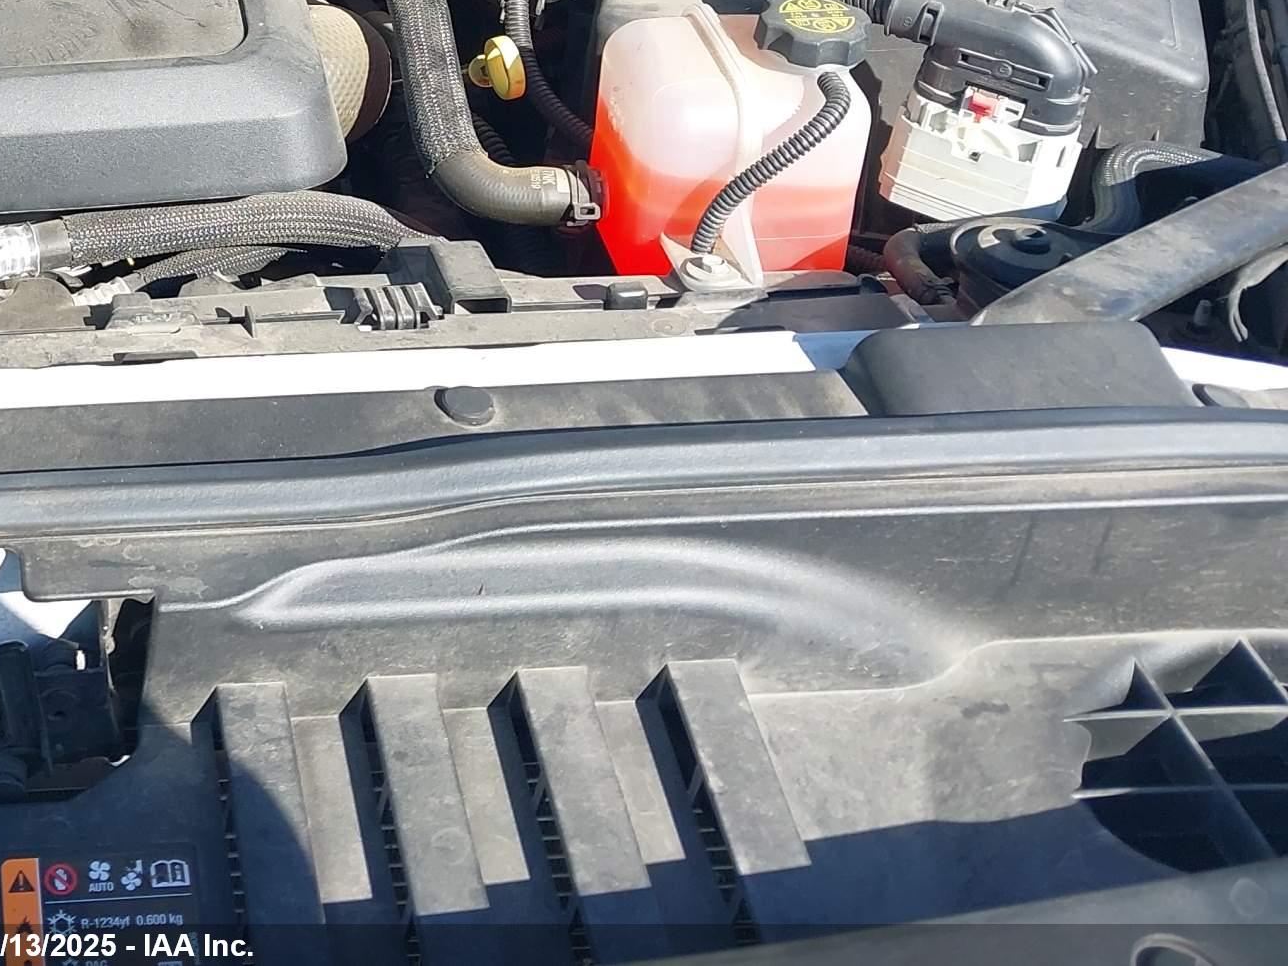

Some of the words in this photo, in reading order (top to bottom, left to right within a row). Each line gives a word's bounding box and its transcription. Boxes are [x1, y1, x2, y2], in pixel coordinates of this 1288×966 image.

[88, 881, 114, 893] AUTO
[81, 915, 131, 930] R-1234yf
[136, 914, 167, 926] 0.600
[169, 913, 184, 927] kg
